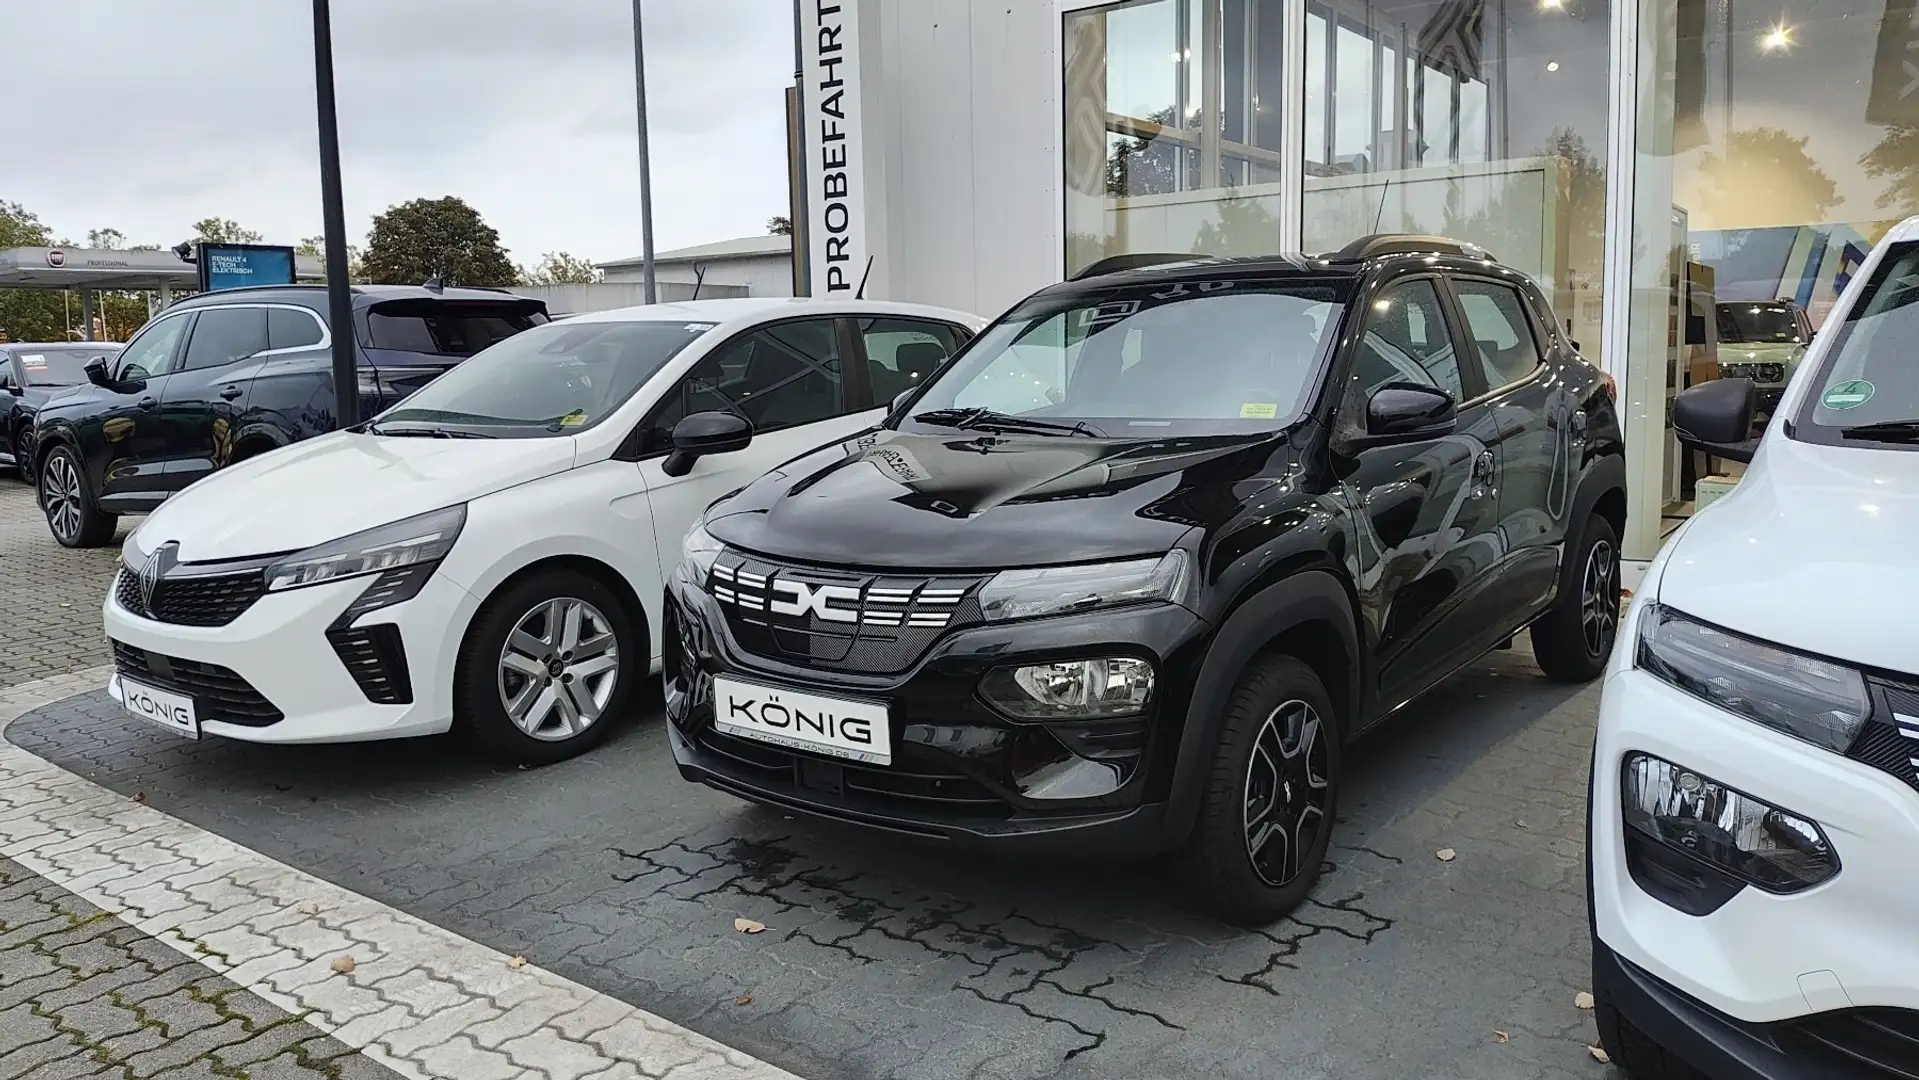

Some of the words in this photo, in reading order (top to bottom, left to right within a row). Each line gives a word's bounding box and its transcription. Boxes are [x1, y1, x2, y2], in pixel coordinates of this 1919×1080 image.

[817, 0, 850, 294] PROBEFAHRT
[86, 259, 129, 267] PROFESSIONAL
[212, 255, 241, 263] RENAULT
[128, 691, 189, 725] KÖNIG
[729, 693, 872, 744] KÖNIG
